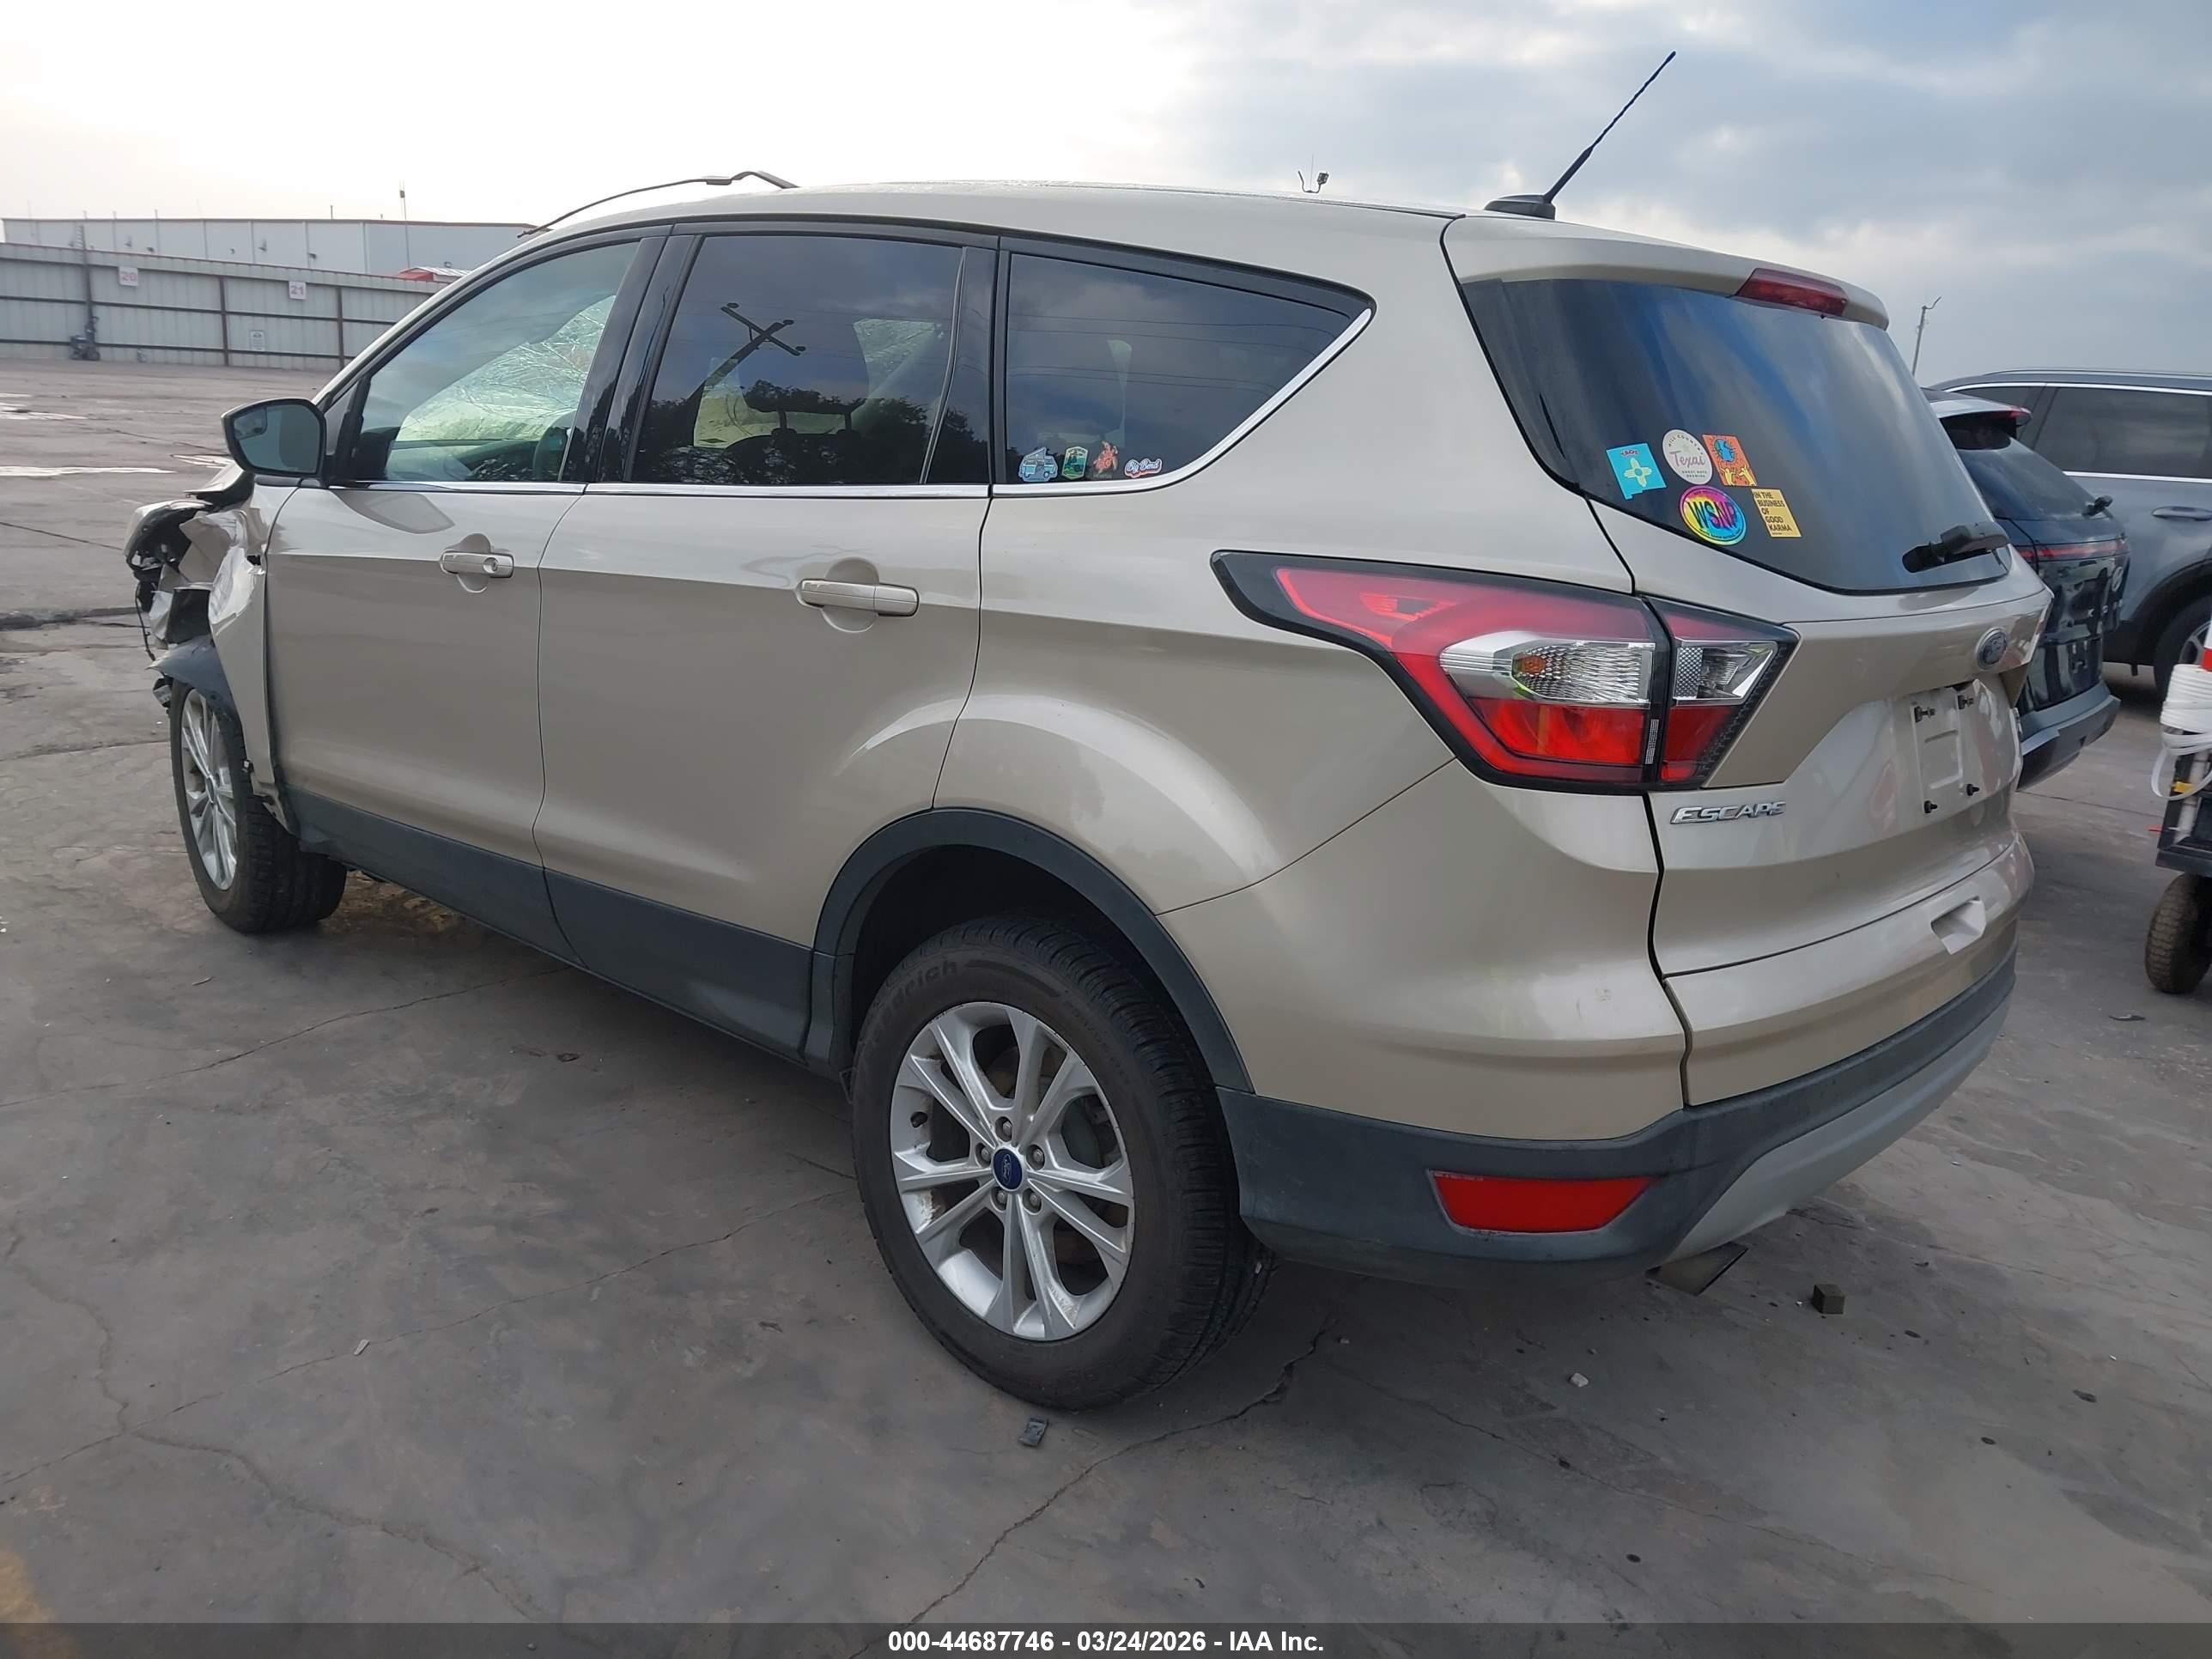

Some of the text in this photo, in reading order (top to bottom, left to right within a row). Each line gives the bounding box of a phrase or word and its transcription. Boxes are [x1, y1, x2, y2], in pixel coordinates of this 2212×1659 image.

[1757, 499, 1786, 507] BUSINESS
[1686, 501, 1737, 530] WSNP
[1765, 515, 1784, 524] GOOD
[1670, 800, 1787, 825] ESCAPE
